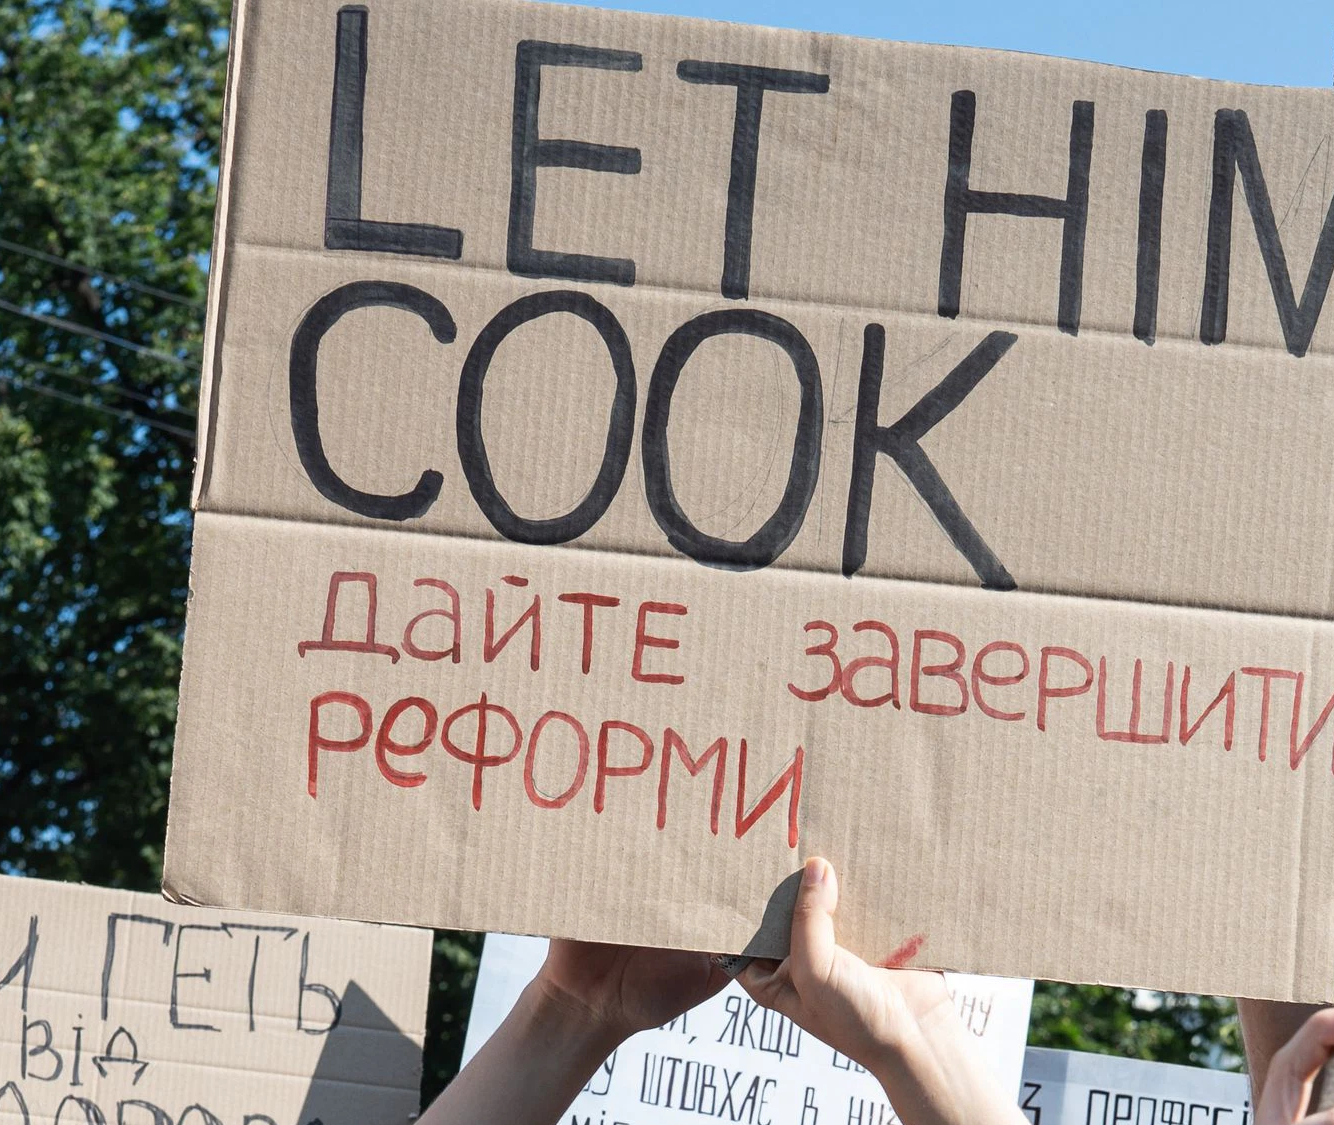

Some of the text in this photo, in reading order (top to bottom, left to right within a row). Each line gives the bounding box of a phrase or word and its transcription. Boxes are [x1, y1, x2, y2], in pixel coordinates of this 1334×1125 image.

[323, 4, 831, 300] LET
[287, 280, 1019, 592] COOK
[100, 911, 344, 1035] ГЕТЬ
